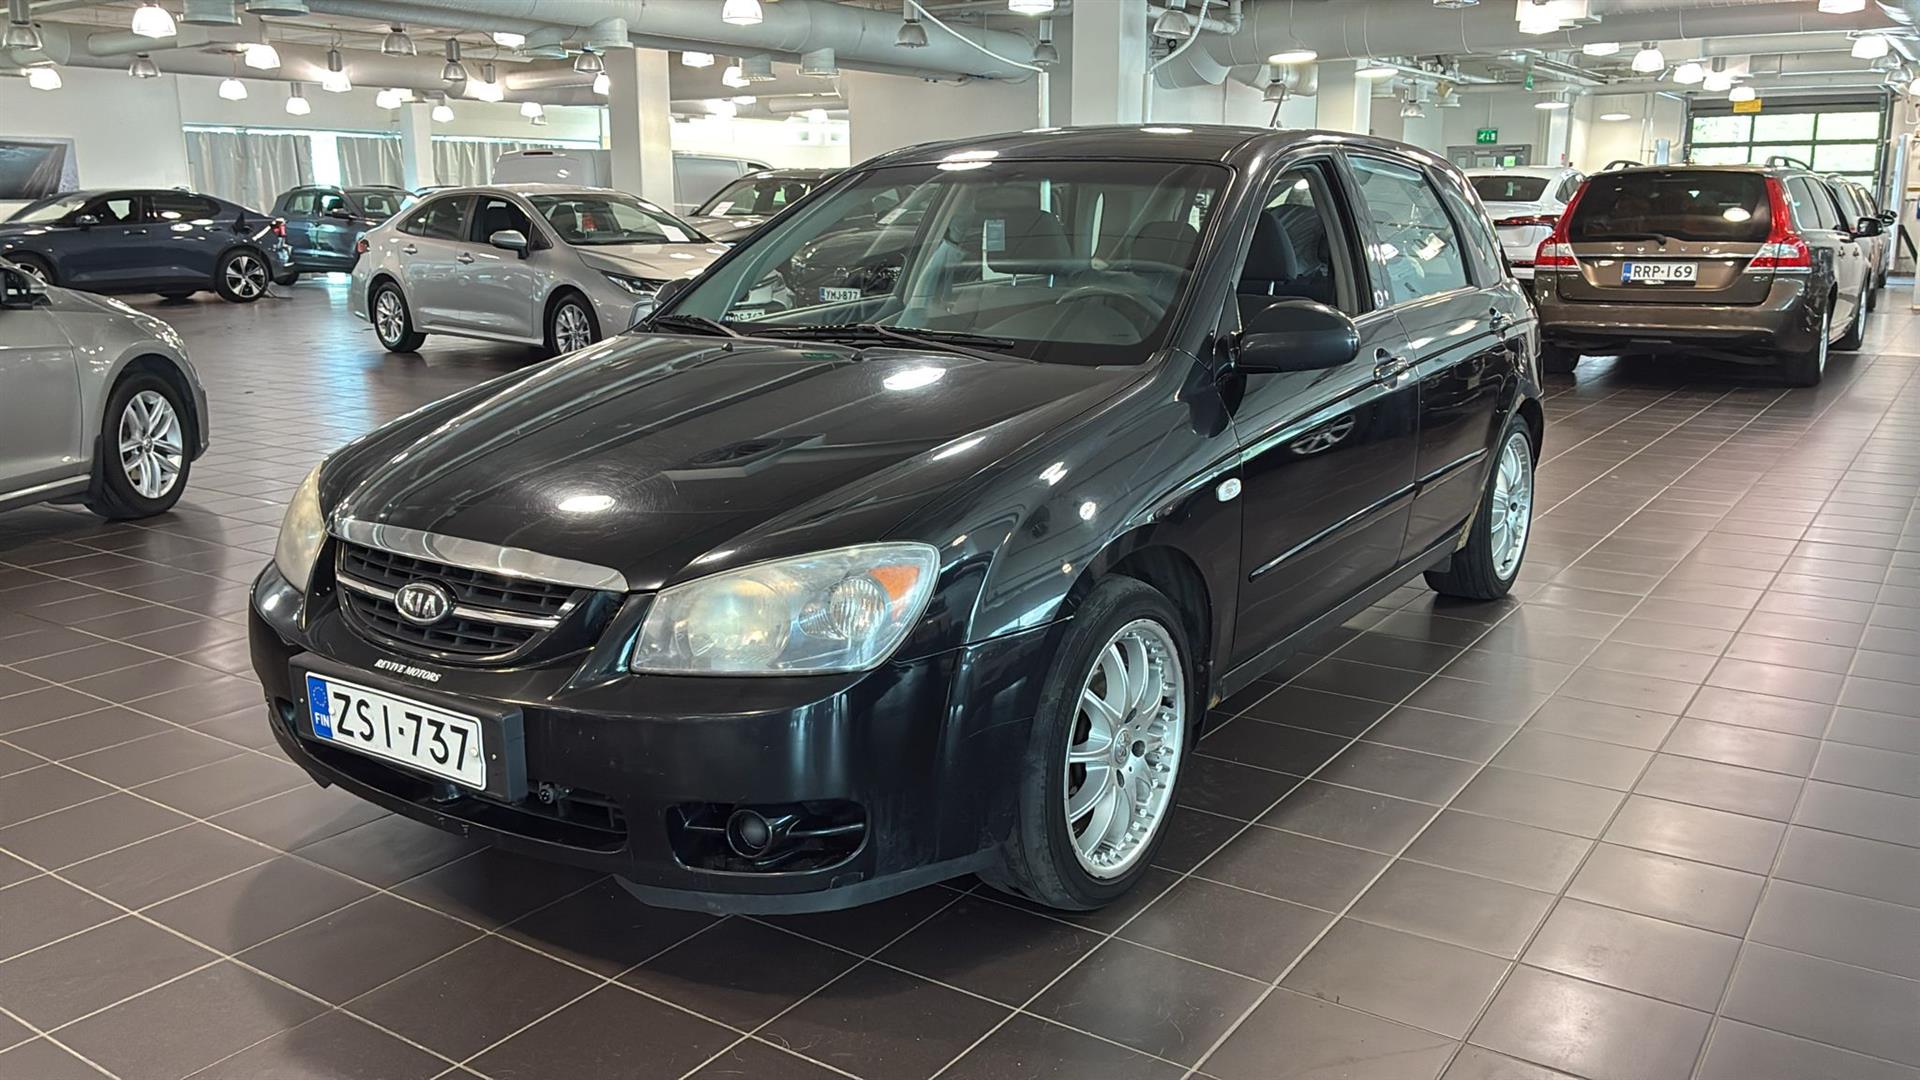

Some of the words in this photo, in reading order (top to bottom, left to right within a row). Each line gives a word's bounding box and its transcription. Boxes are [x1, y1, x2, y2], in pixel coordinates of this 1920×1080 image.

[1633, 265, 1693, 278] RRP-169
[403, 589, 437, 617] KIA
[374, 659, 407, 673] REVIVE
[403, 666, 442, 682] MOTORS
[315, 712, 330, 728] FIN
[333, 691, 469, 771] ZSI-737
